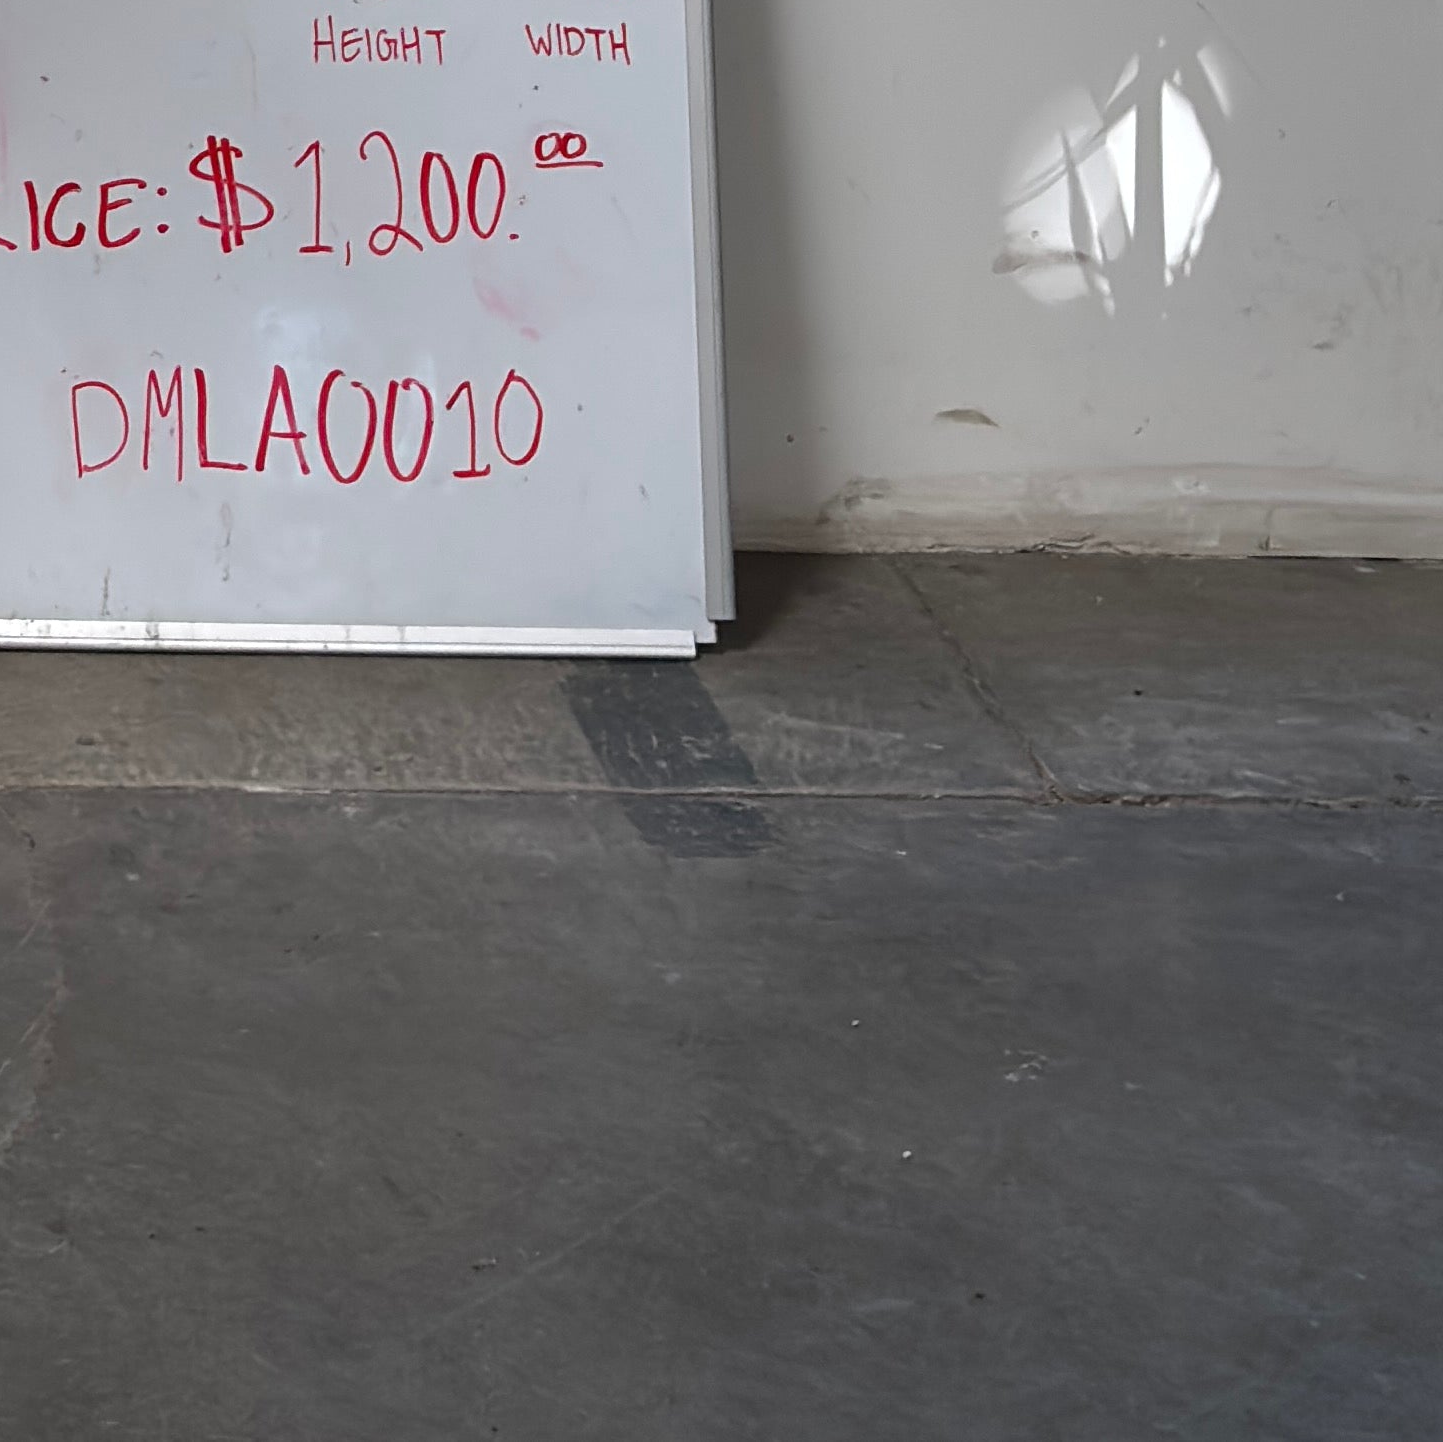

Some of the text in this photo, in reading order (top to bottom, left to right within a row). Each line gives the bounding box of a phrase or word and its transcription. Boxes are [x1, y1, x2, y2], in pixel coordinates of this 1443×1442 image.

[312, 18, 631, 65] HEIGHT WIDTH
[71, 363, 544, 485] DMLA0010
